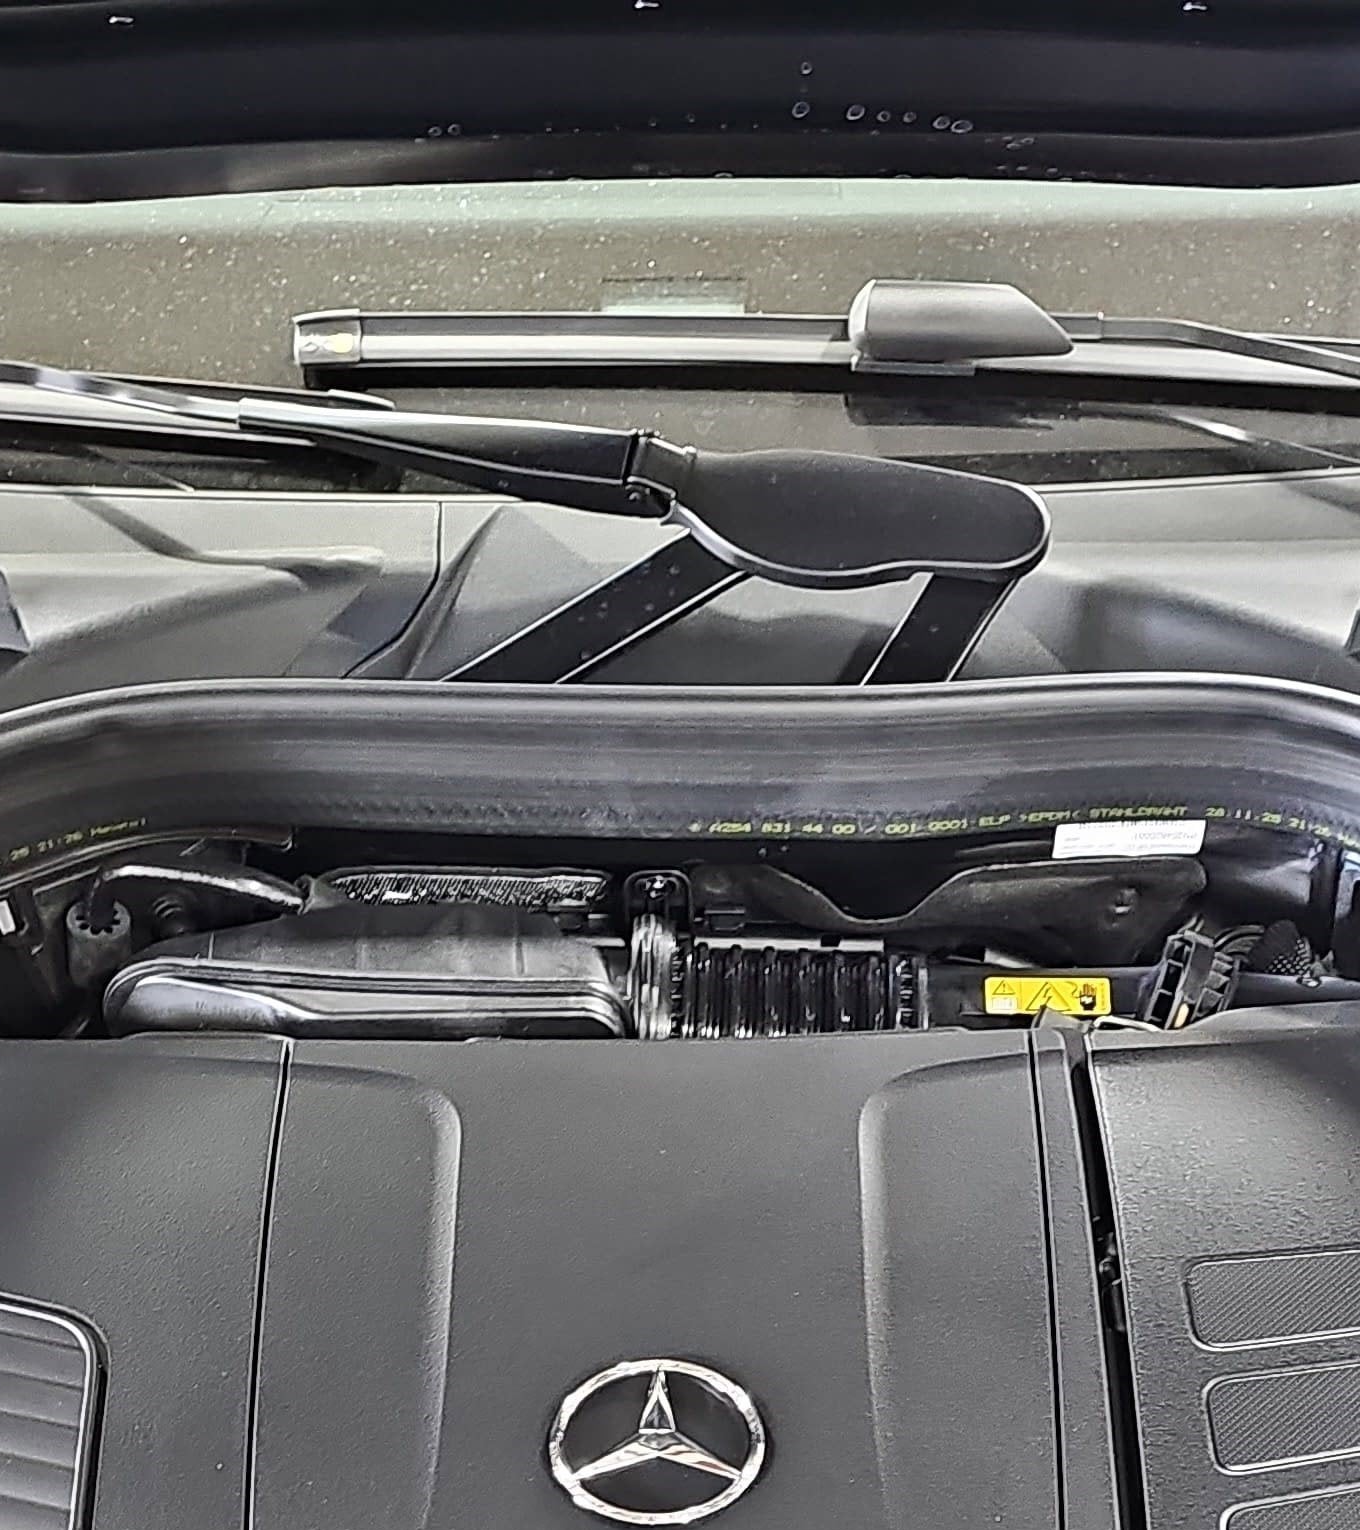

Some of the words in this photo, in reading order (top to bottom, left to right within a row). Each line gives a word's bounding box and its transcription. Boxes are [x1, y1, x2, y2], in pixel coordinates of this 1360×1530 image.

[802, 823, 823, 833] 44
[832, 823, 855, 835] 00
[885, 823, 916, 834] 001
[928, 819, 969, 832] 0001
